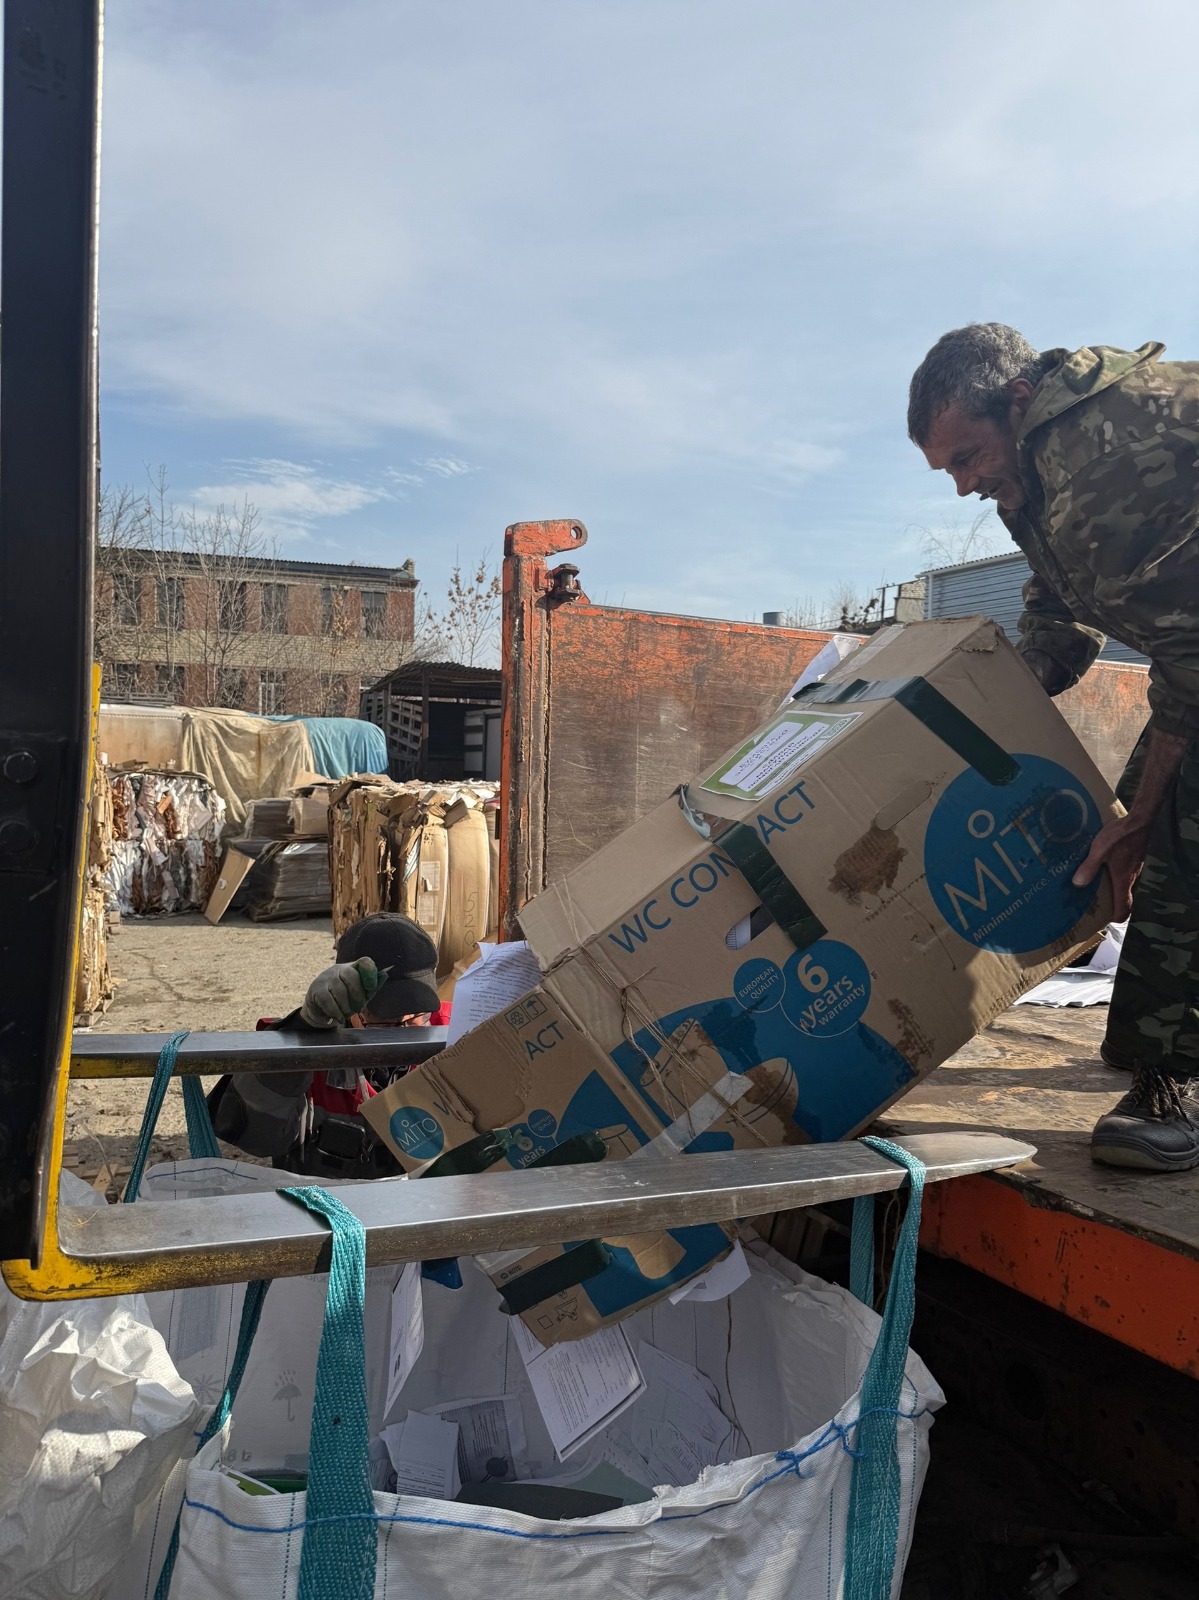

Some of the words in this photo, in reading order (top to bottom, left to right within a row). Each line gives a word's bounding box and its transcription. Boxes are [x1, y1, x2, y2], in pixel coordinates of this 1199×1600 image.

[943, 788, 1089, 931] MITO
[608, 898, 672, 954] WC
[972, 898, 1024, 942] Minimum
[740, 966, 775, 998] EUROPEAN
[750, 973, 779, 999] QUALITY
[796, 953, 829, 993] 6
[801, 975, 853, 1029] years
[818, 984, 867, 1026] warranty
[396, 1117, 438, 1150] MITO
[517, 1145, 547, 1168] years
